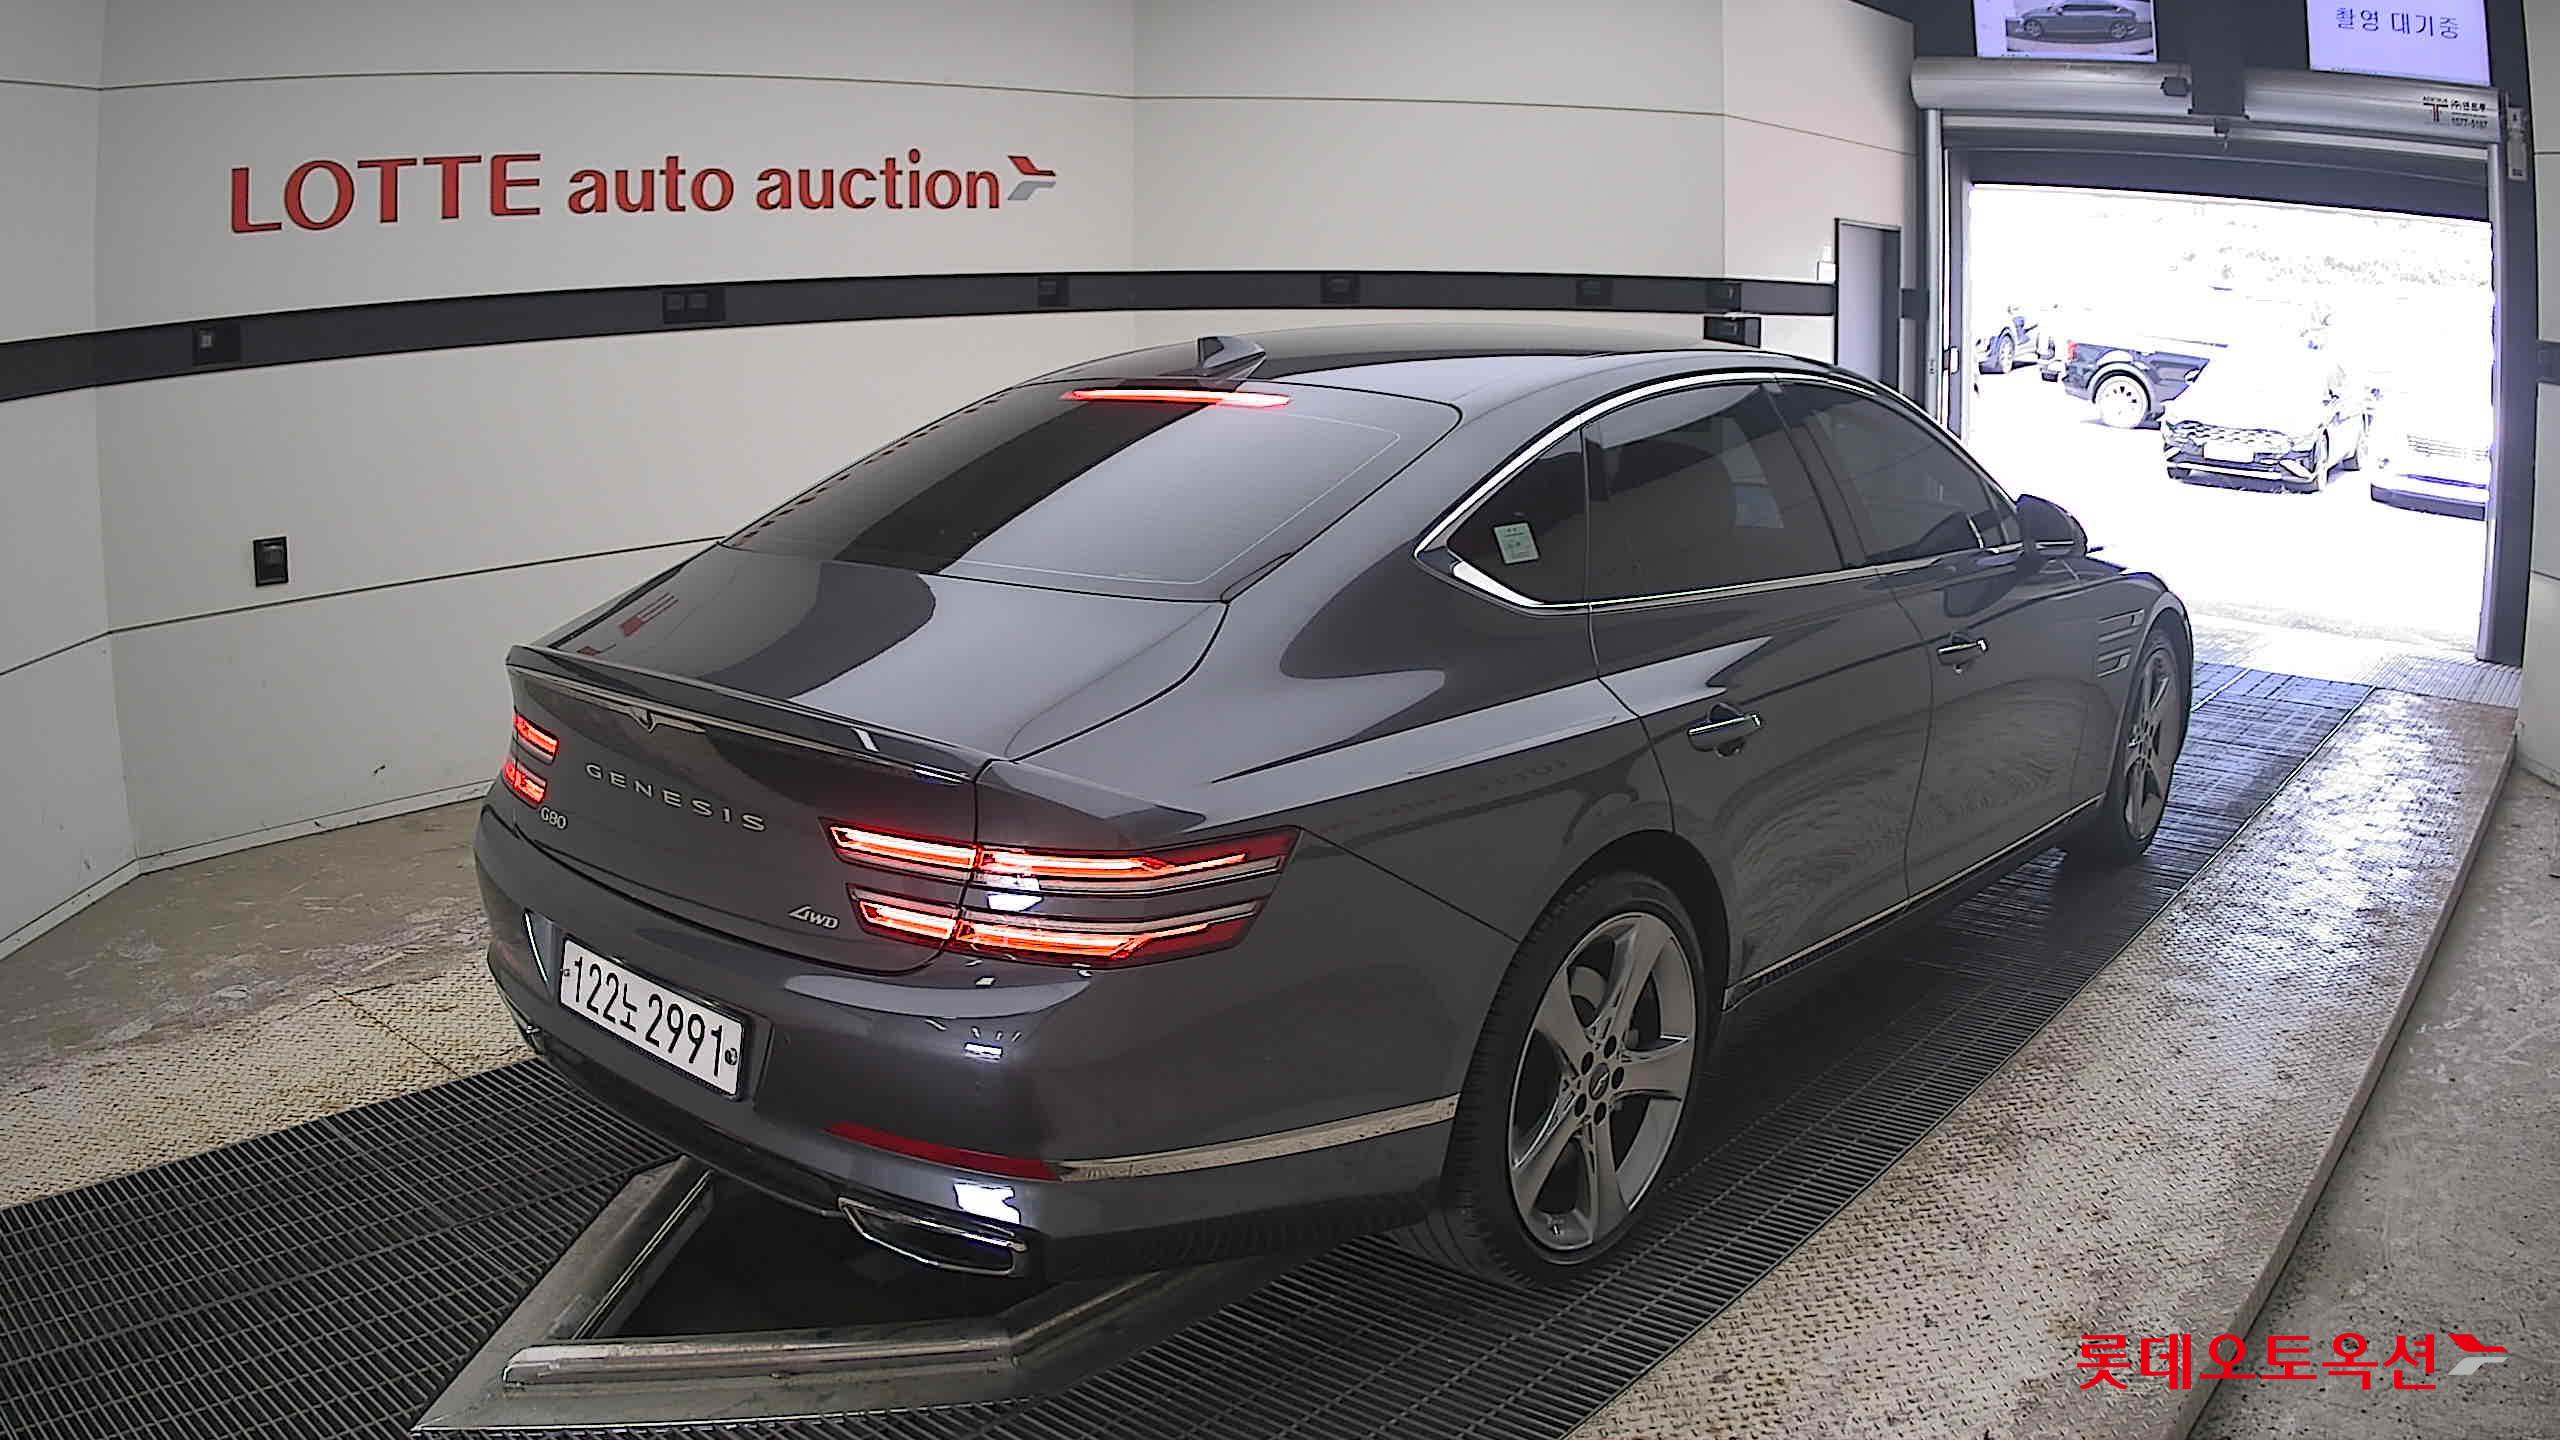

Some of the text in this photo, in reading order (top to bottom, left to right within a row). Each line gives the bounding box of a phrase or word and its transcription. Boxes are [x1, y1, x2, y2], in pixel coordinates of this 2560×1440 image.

[2391, 12, 2458, 39] 대기중
[231, 148, 1001, 233] LOTTE auto auction
[540, 806, 567, 830] G80
[585, 763, 766, 832] GENESIS
[574, 956, 724, 1077] 122노 2991
